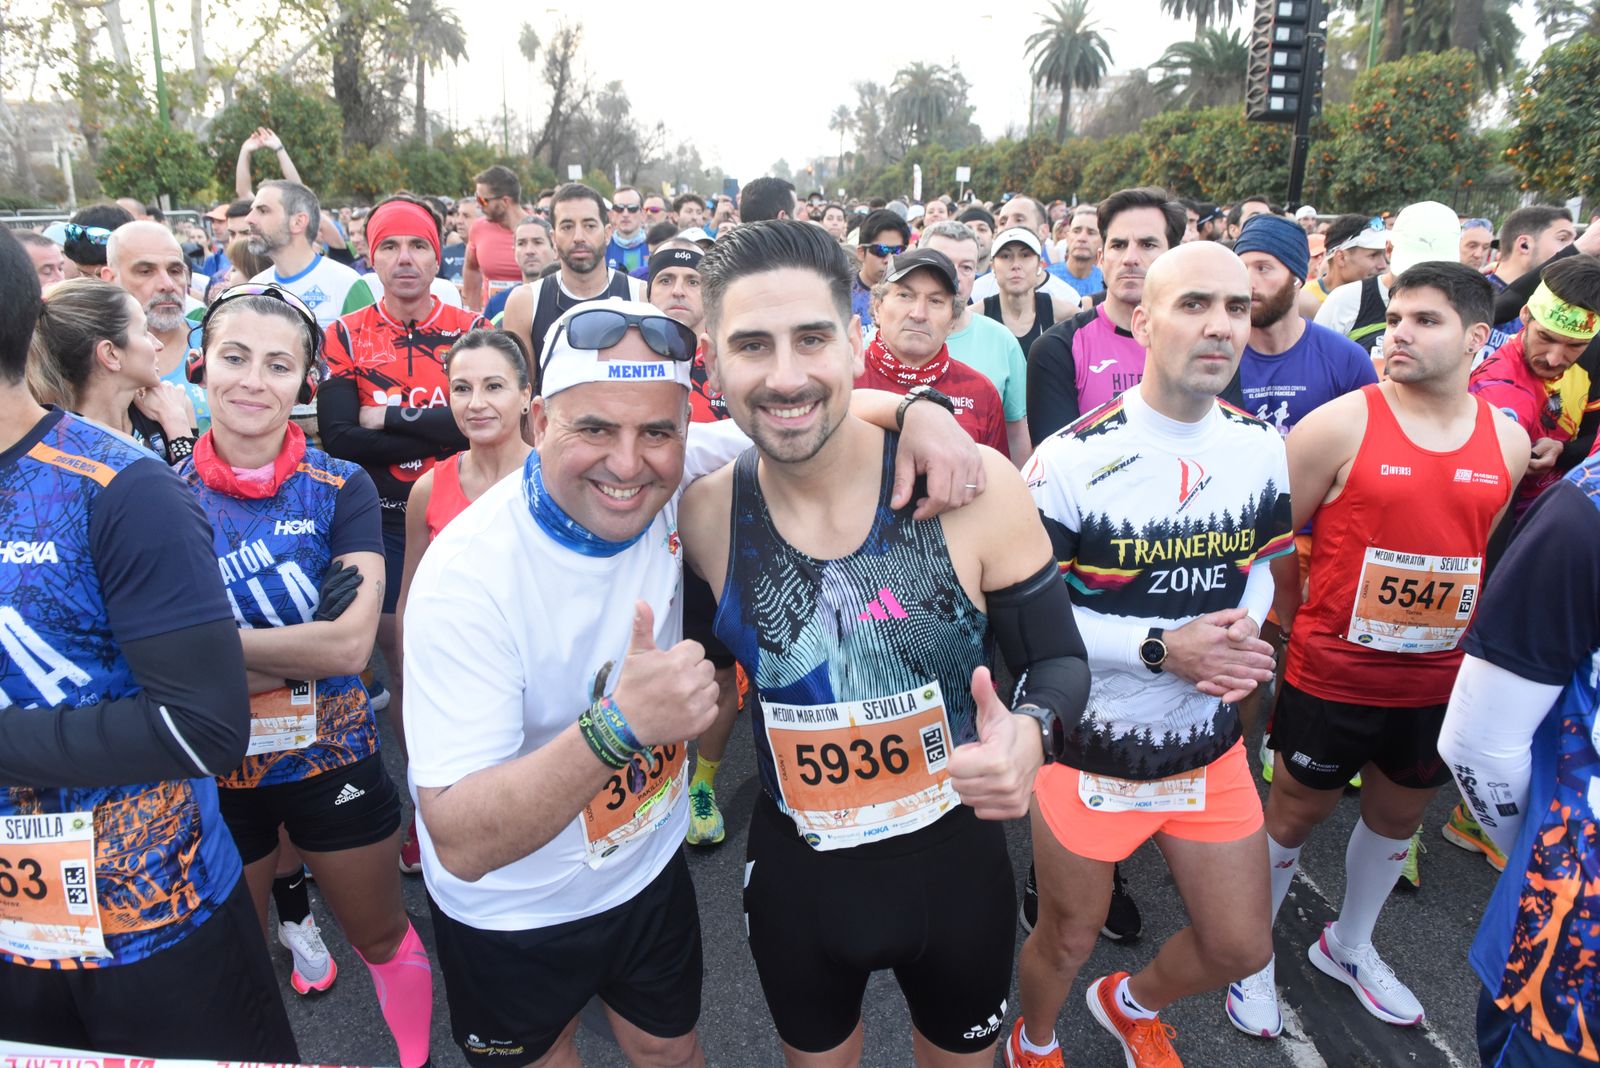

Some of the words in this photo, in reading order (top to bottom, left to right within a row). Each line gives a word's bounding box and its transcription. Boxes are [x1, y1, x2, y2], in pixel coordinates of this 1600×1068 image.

[673, 251, 691, 261] edp
[608, 364, 666, 378] MENITA
[1375, 550, 1394, 563] MEDIO
[1396, 554, 1425, 567] MARATÓN
[1440, 557, 1469, 571] SEVILLA
[1147, 563, 1227, 597] ZONE
[1378, 576, 1455, 609] 5547
[772, 707, 795, 723] MEDIO
[796, 707, 839, 723] MARATÓN
[862, 693, 917, 721] SEVILLA
[796, 734, 909, 786] 5936
[334, 789, 365, 806] adidas
[637, 777, 664, 801] PAKILLO
[5, 816, 63, 840] SEVILLA
[864, 825, 889, 837] HOKA
